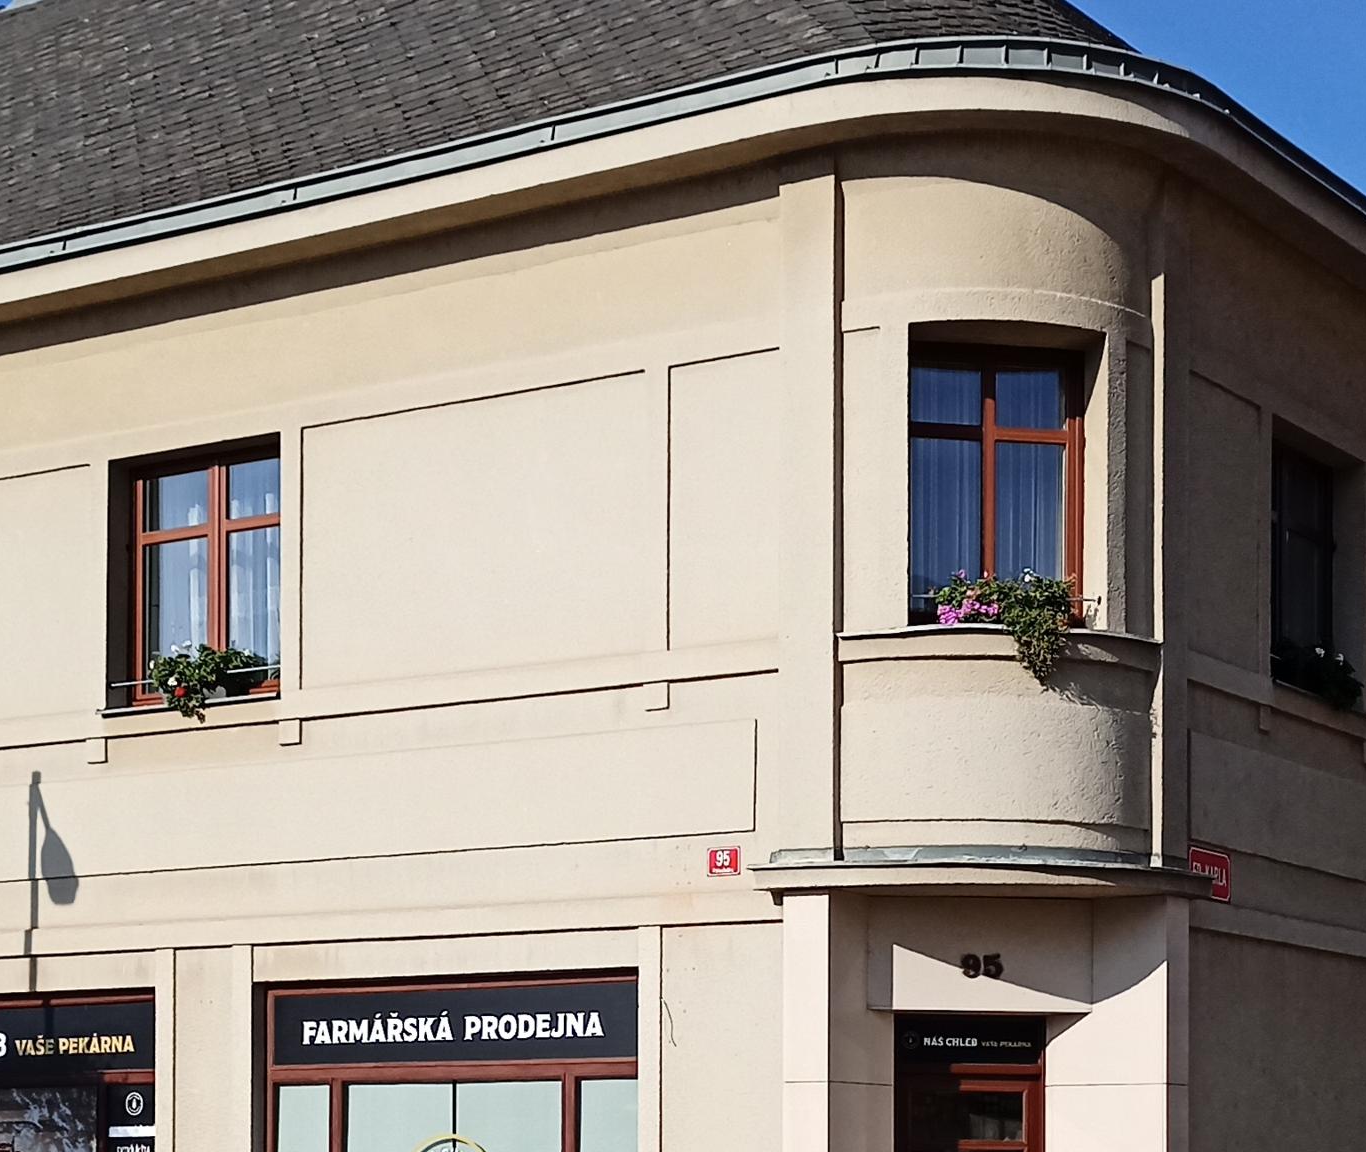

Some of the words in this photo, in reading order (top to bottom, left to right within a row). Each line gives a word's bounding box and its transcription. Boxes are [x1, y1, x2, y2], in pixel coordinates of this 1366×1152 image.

[715, 850, 731, 867] 95
[961, 953, 1004, 980] 95
[302, 1010, 454, 1045] FARMÁŘSKÁ
[463, 1012, 605, 1041] PRODEJNA
[14, 1034, 55, 1056] VAŠE
[58, 1032, 136, 1055] PEKÁRNA
